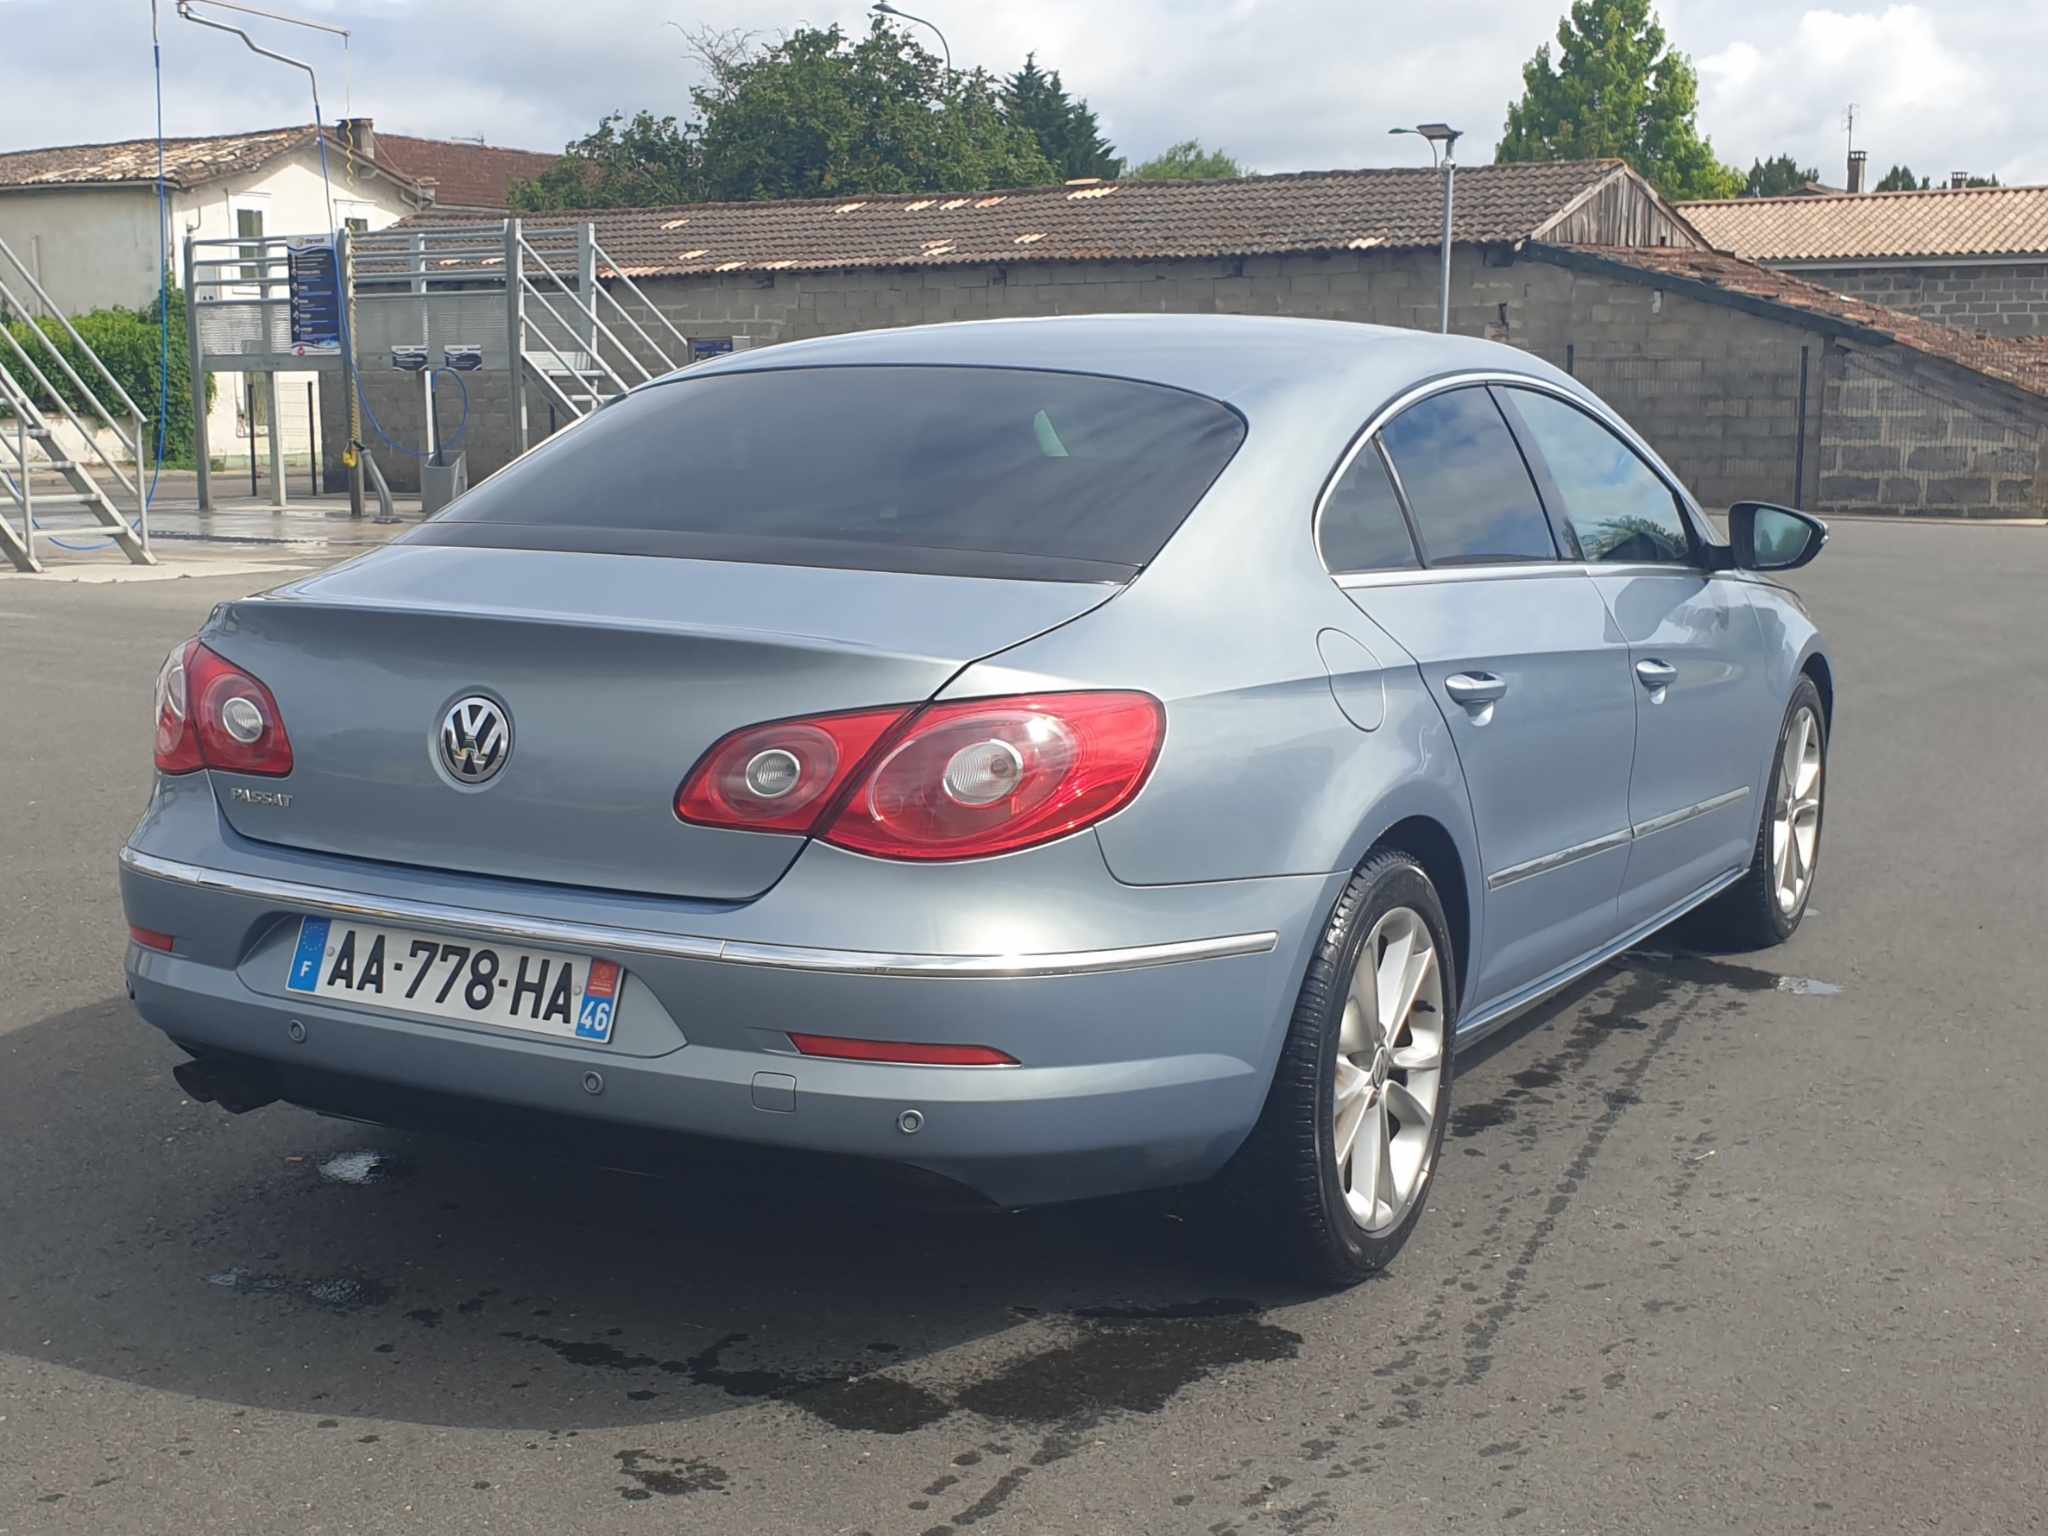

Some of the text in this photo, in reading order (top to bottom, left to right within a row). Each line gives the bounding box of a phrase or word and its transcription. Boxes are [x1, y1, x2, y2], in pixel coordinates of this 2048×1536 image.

[438, 695, 510, 784] VW
[231, 788, 294, 808] PASSAT
[300, 960, 312, 977] F
[327, 930, 573, 1024] AA-778-HA
[579, 1000, 610, 1032] 46
